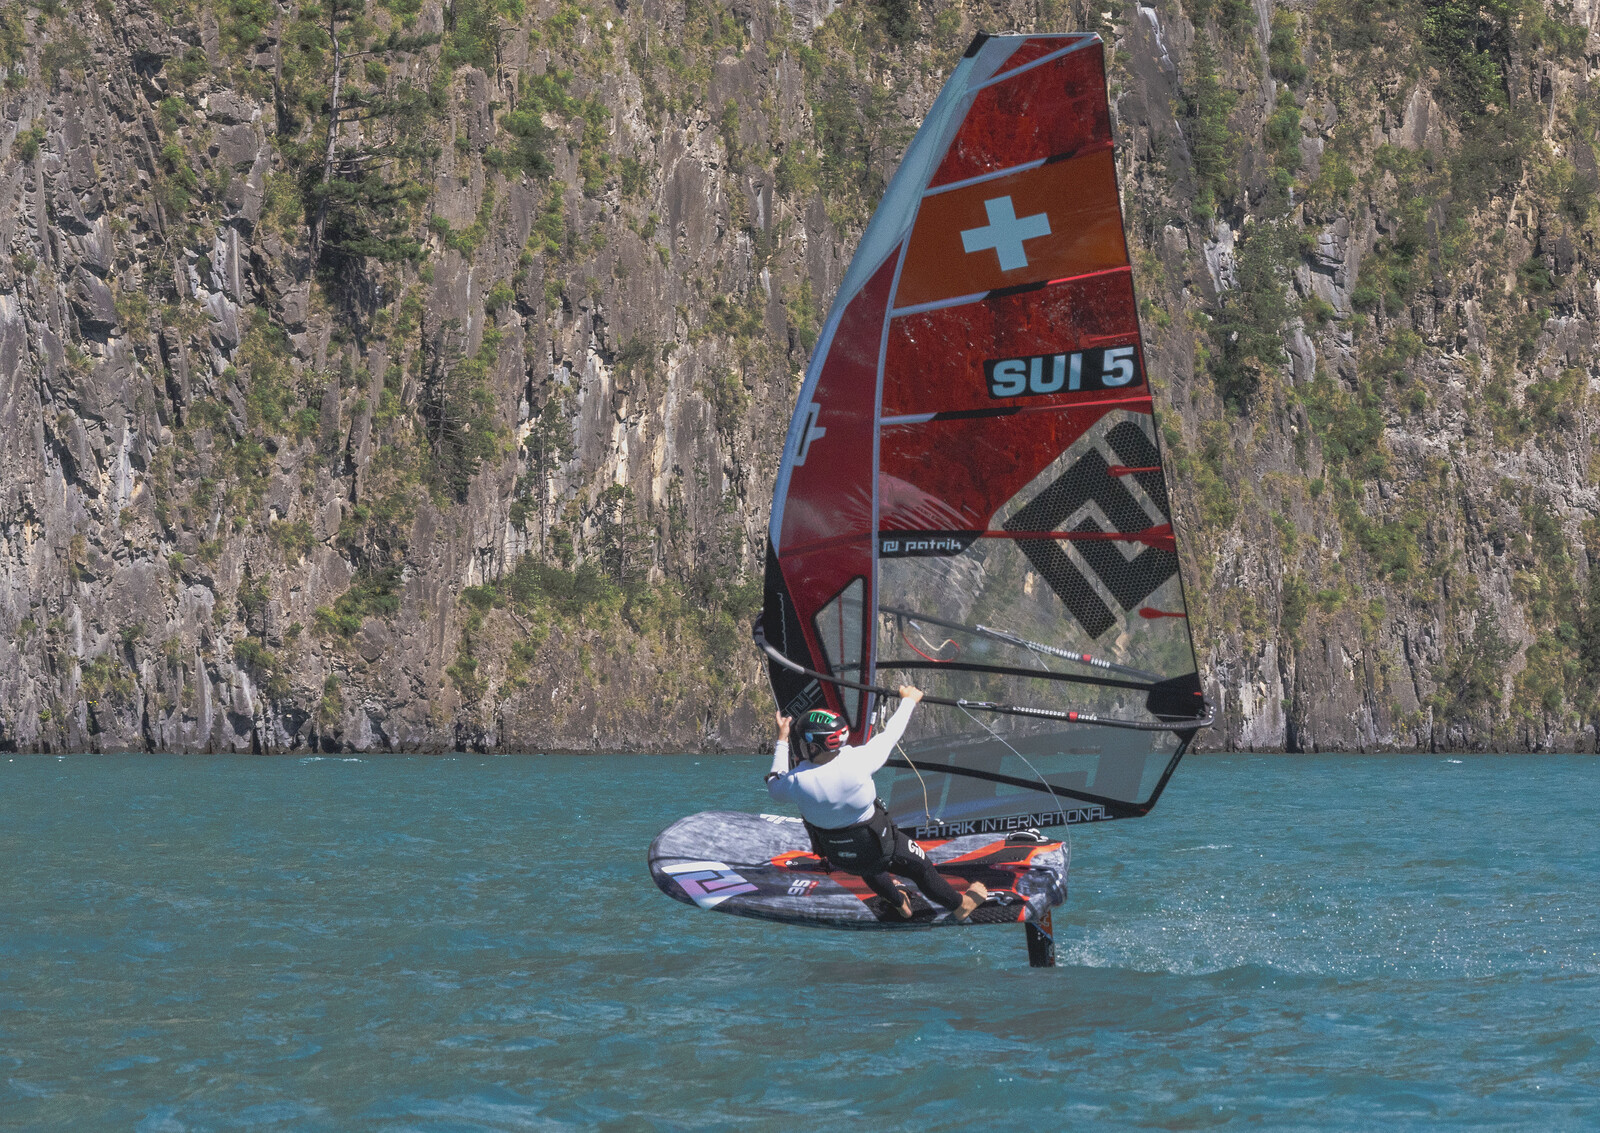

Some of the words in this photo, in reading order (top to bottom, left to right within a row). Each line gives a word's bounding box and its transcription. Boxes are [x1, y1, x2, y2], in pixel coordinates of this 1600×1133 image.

[992, 354, 1082, 397] SUI
[1101, 346, 1135, 387] 5
[905, 539, 962, 552] patrik
[915, 820, 976, 839] PATRIK
[981, 806, 1114, 832] INTERNATIONAL
